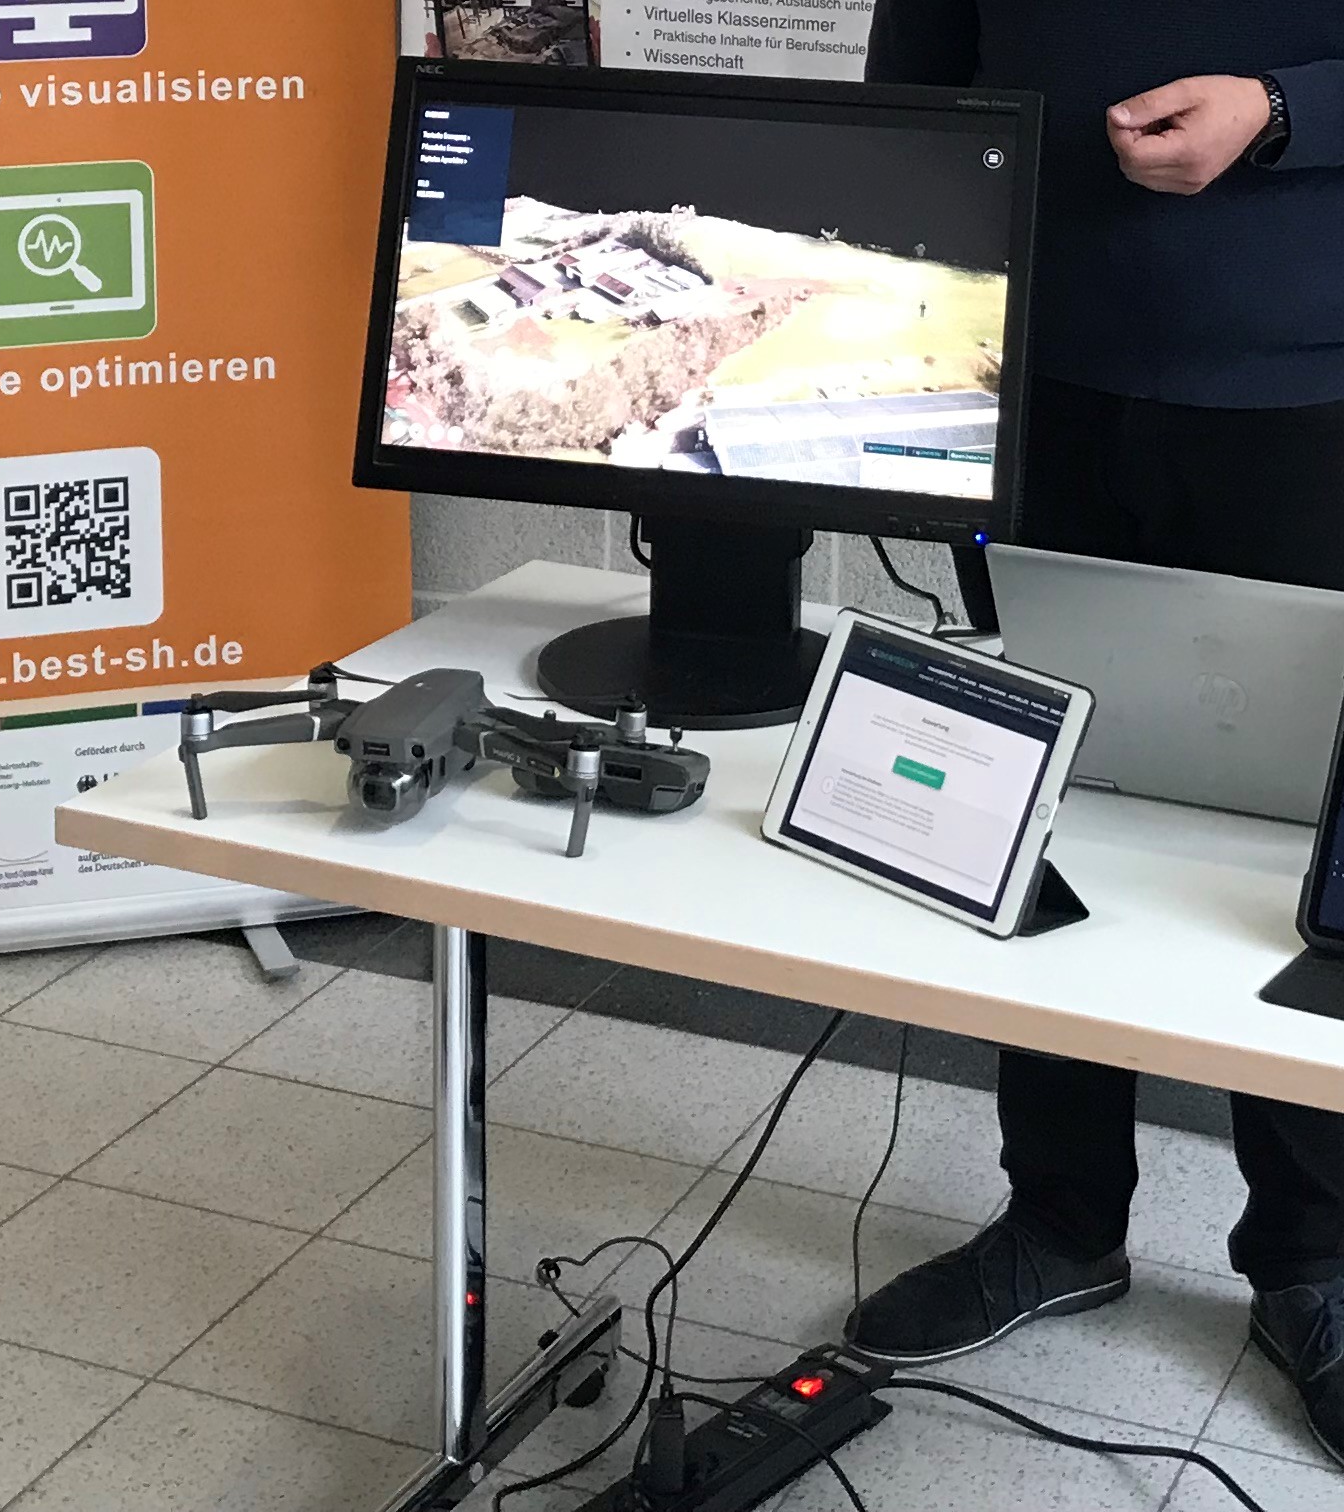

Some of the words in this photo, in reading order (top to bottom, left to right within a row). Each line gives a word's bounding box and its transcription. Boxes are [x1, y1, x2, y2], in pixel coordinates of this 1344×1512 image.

[643, 5, 713, 25] Virtuelles
[717, 10, 837, 33] Klassenzimmer
[414, 64, 445, 75] NEC
[643, 47, 744, 70] Wissenschaft
[19, 69, 305, 108] visualisieren
[40, 352, 276, 398] optimieren
[75, 744, 117, 757] Gefördert
[119, 742, 145, 753] durch
